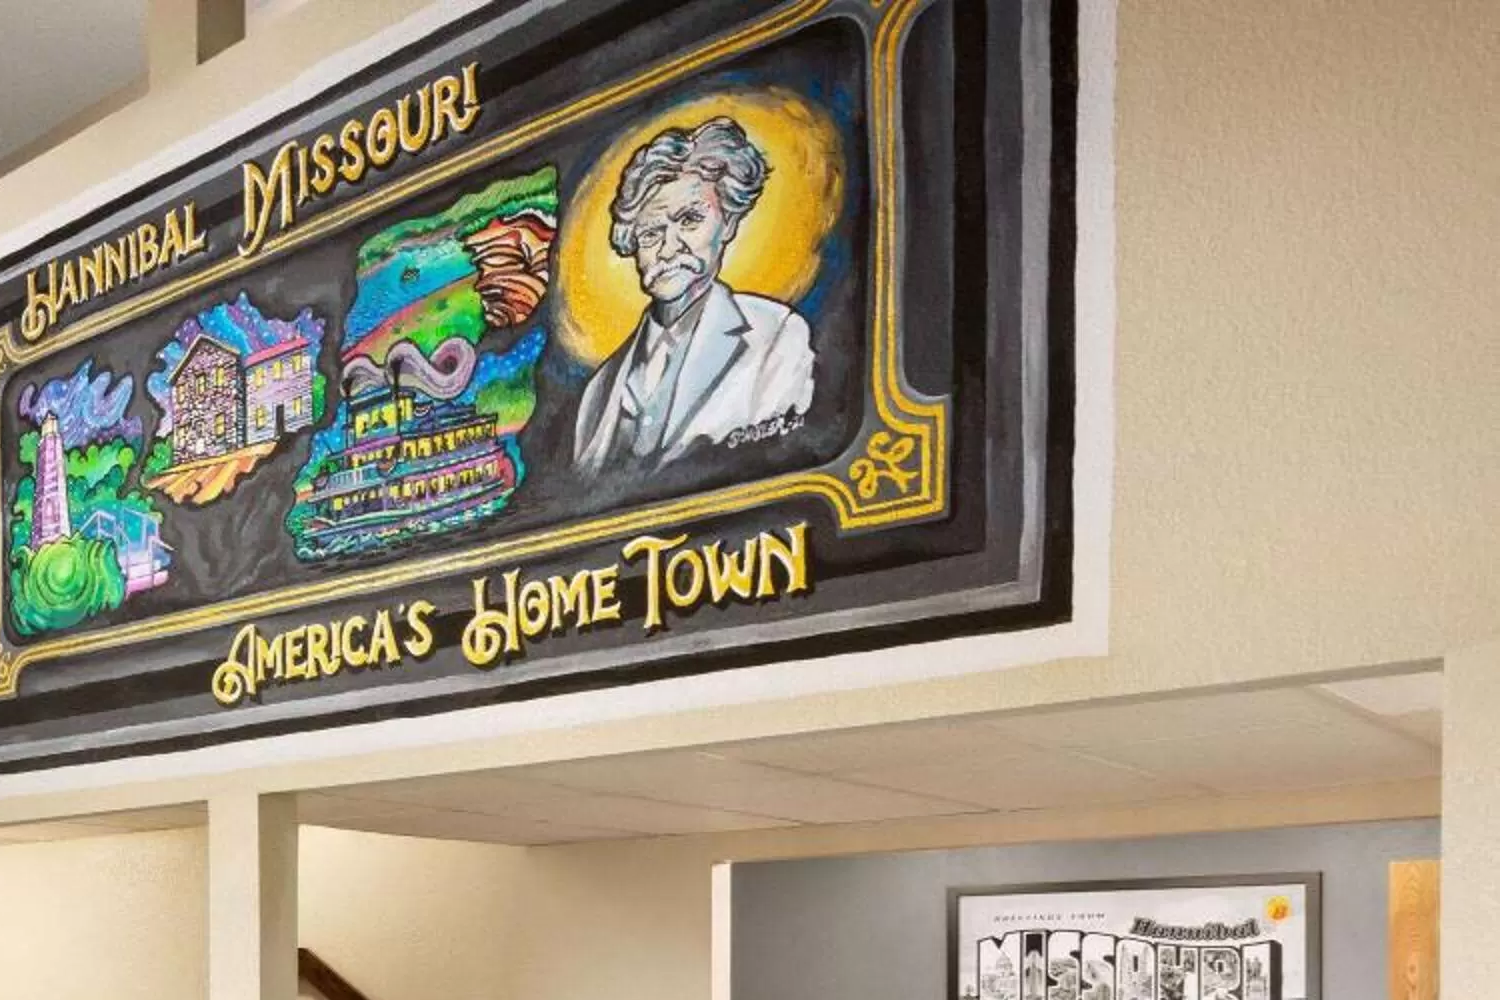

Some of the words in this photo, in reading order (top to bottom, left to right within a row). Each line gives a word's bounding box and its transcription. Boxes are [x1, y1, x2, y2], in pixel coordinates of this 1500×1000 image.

[21, 203, 208, 341] HANNIBAL
[238, 61, 482, 257] MISSOURI
[212, 600, 437, 705] AMERICA'S
[461, 565, 622, 667] HOME
[622, 520, 809, 630] TOWN
